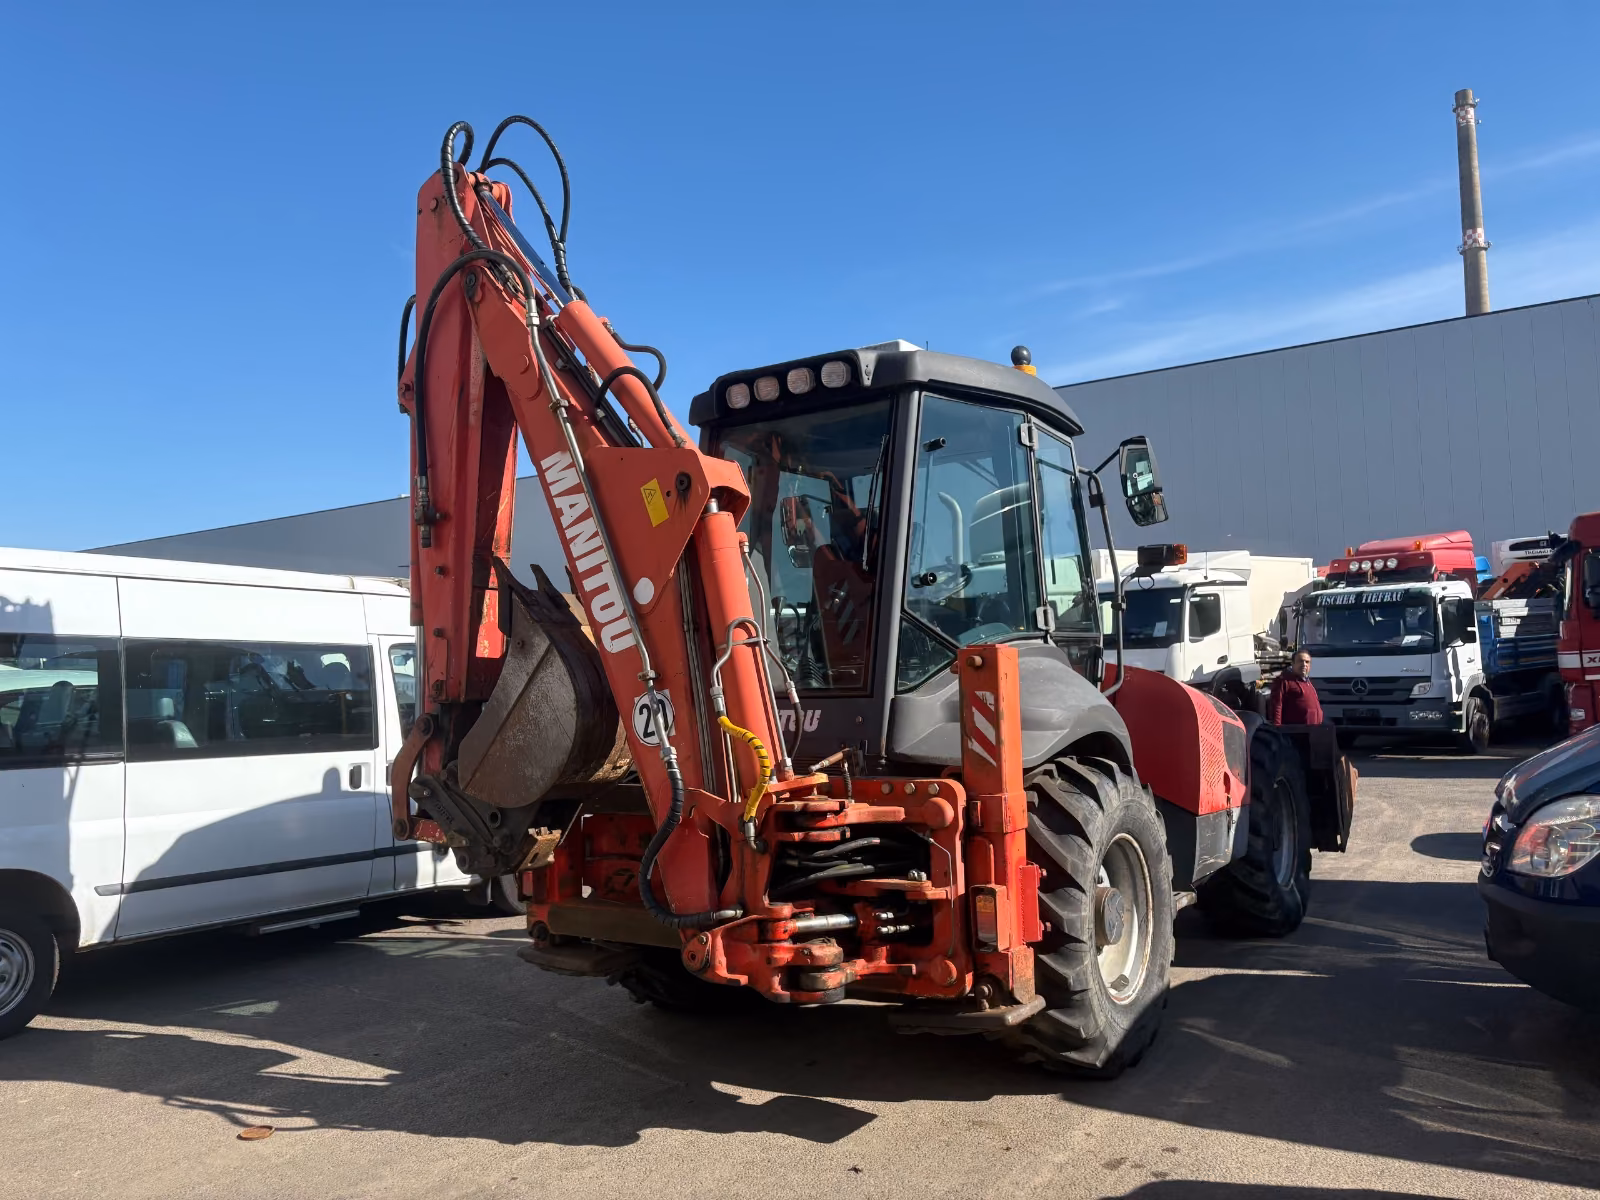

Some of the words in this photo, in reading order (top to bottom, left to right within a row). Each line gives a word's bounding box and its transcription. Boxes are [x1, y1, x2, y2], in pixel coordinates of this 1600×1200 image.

[540, 451, 637, 654] MANITOU
[1316, 594, 1356, 606] FISCHER
[1361, 591, 1405, 604] TIEFBAU
